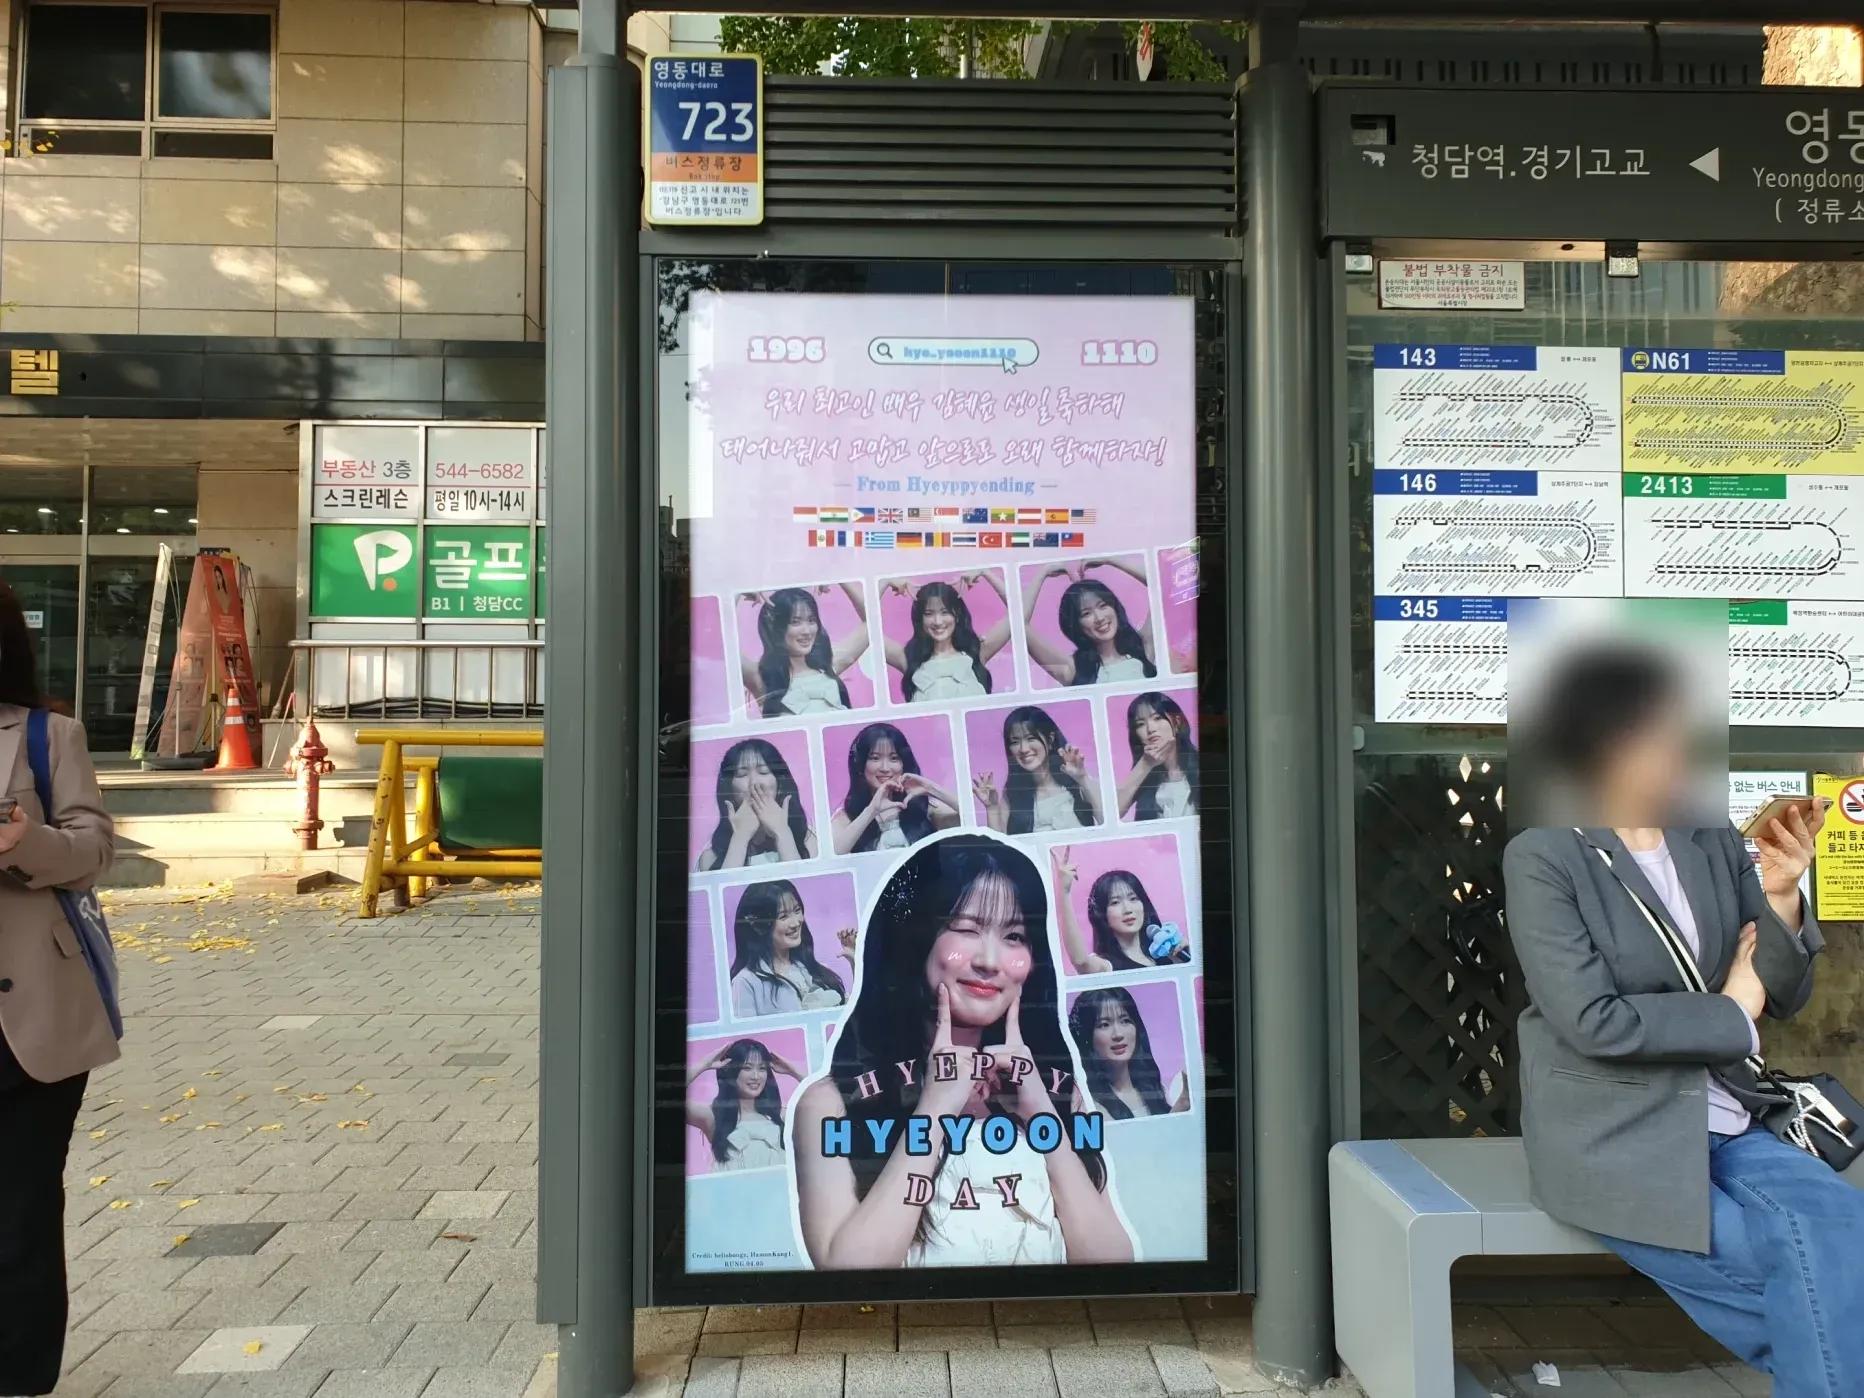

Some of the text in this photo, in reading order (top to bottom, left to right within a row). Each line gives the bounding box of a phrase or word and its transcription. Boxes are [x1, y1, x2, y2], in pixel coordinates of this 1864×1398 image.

[654, 61, 725, 80] 영동대로
[678, 102, 754, 142] 723
[667, 156, 742, 171] 버스정류장
[1752, 167, 1864, 193] Yeongdong
[1403, 264, 1504, 277] 불법 부착물 금지
[747, 336, 826, 361] 1996
[1081, 340, 1158, 366] 1110
[1400, 348, 1436, 366] 143
[1652, 352, 1690, 370] N61
[10, 349, 59, 395] 텔
[765, 385, 1126, 426] 우리 최고인 배우 김혜윤 생일 축하해
[720, 434, 1168, 469] 태어나줘서 고맙고 앞으로도 오래 함께하자!
[321, 460, 412, 479] 부동산 3층
[435, 463, 524, 480] 544-6582
[857, 476, 1035, 496] From Hyeyppyending
[1400, 473, 1437, 492] 146
[1641, 476, 1693, 494] 2413
[323, 488, 409, 509] 스크린레슨
[435, 490, 460, 511] 평일
[429, 541, 527, 589] 골프
[431, 595, 524, 612] B1 청담CC
[1400, 599, 1438, 618] 345
[1733, 780, 1755, 792] 없는
[1757, 781, 1778, 792] 버스
[1780, 780, 1801, 792] 안내
[1827, 831, 1846, 840] 커피
[1849, 831, 1858, 840] 등
[1828, 843, 1846, 852] 들고
[854, 1052, 1071, 1099] HYEPPY
[821, 1111, 1104, 1157] HYEYOON
[903, 1172, 1022, 1210] DAY
